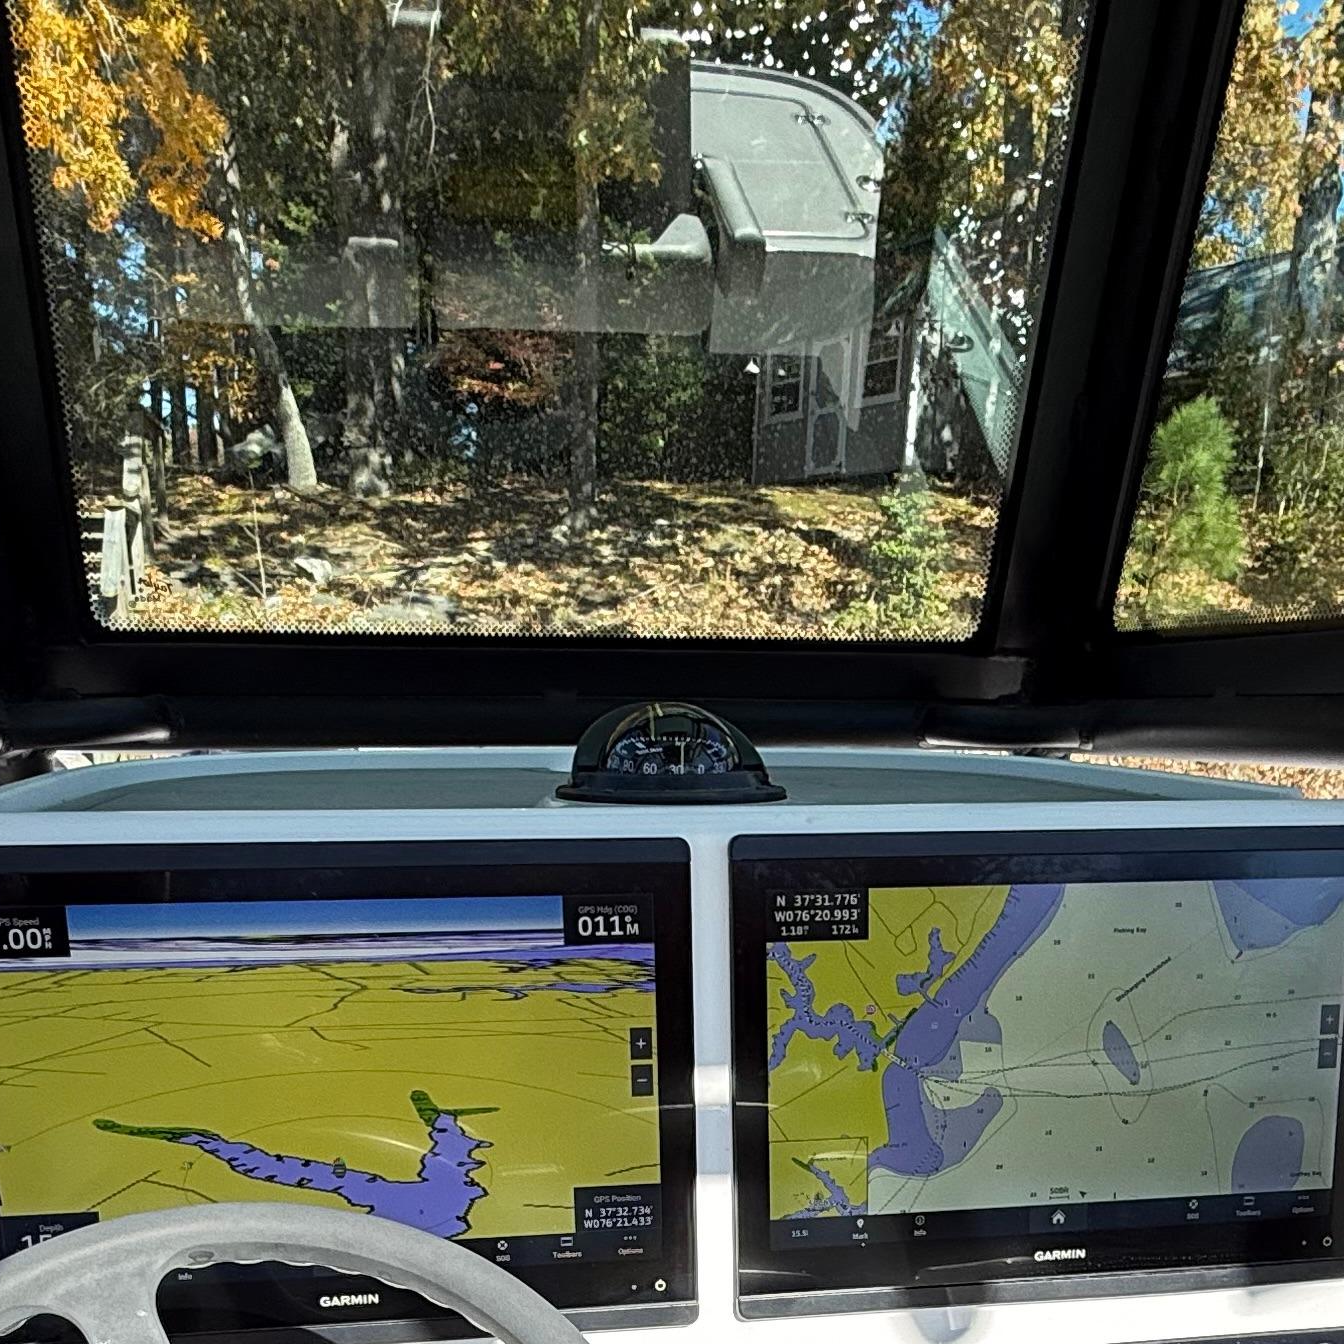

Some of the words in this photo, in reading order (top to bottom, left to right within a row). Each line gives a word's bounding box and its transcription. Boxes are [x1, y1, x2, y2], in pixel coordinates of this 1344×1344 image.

[776, 895, 786, 907] N
[578, 906, 595, 914] GPS
[12, 917, 40, 927] Speed
[594, 1195, 611, 1203] GPS
[612, 1194, 642, 1203] Position
[585, 1208, 594, 1218] N
[39, 1224, 64, 1232] Depth
[1034, 1248, 1087, 1262] GARMIN
[319, 1293, 379, 1308] GARMIN
